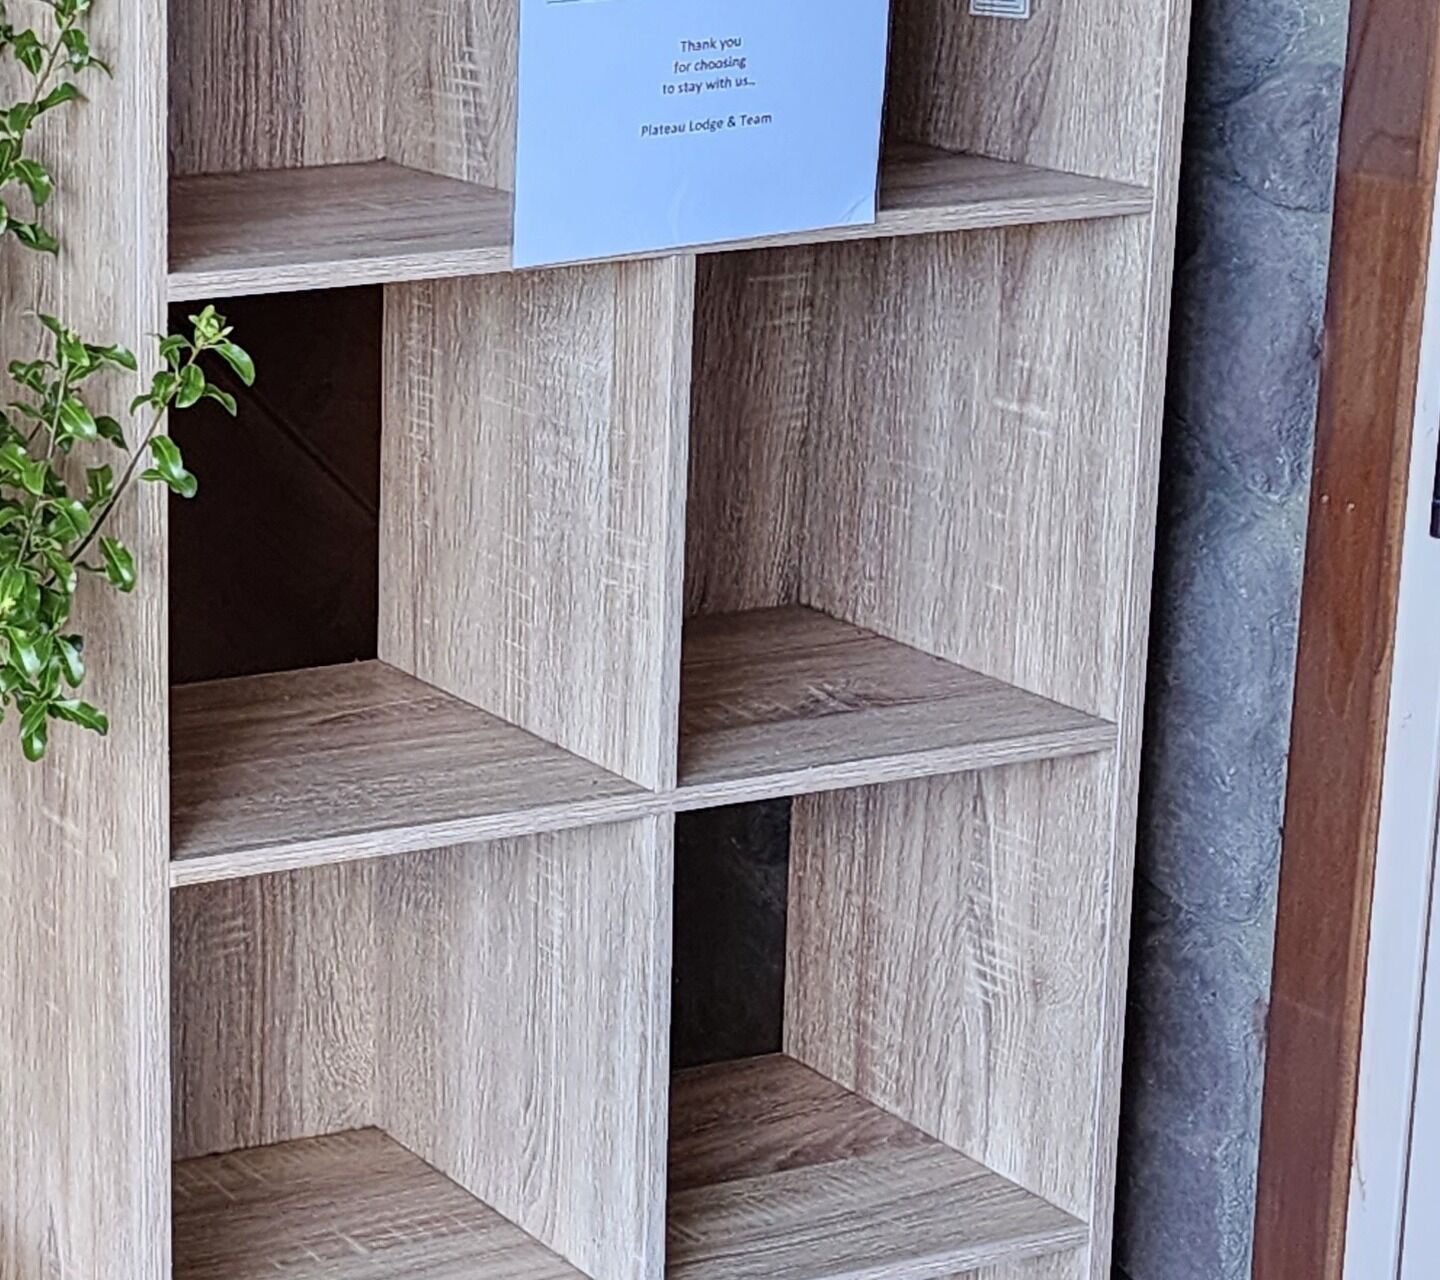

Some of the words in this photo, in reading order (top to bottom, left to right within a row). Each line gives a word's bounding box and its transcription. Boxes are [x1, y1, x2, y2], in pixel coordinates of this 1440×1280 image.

[680, 37, 717, 53] Thank
[719, 37, 742, 51] you
[674, 61, 690, 74] for
[694, 56, 747, 71] choosing
[662, 84, 675, 95] to
[678, 82, 702, 94] stay
[706, 77, 732, 90] with
[641, 123, 686, 137] Plateau
[689, 119, 724, 132] Lodge
[727, 116, 736, 127] &
[741, 113, 772, 126] Team
